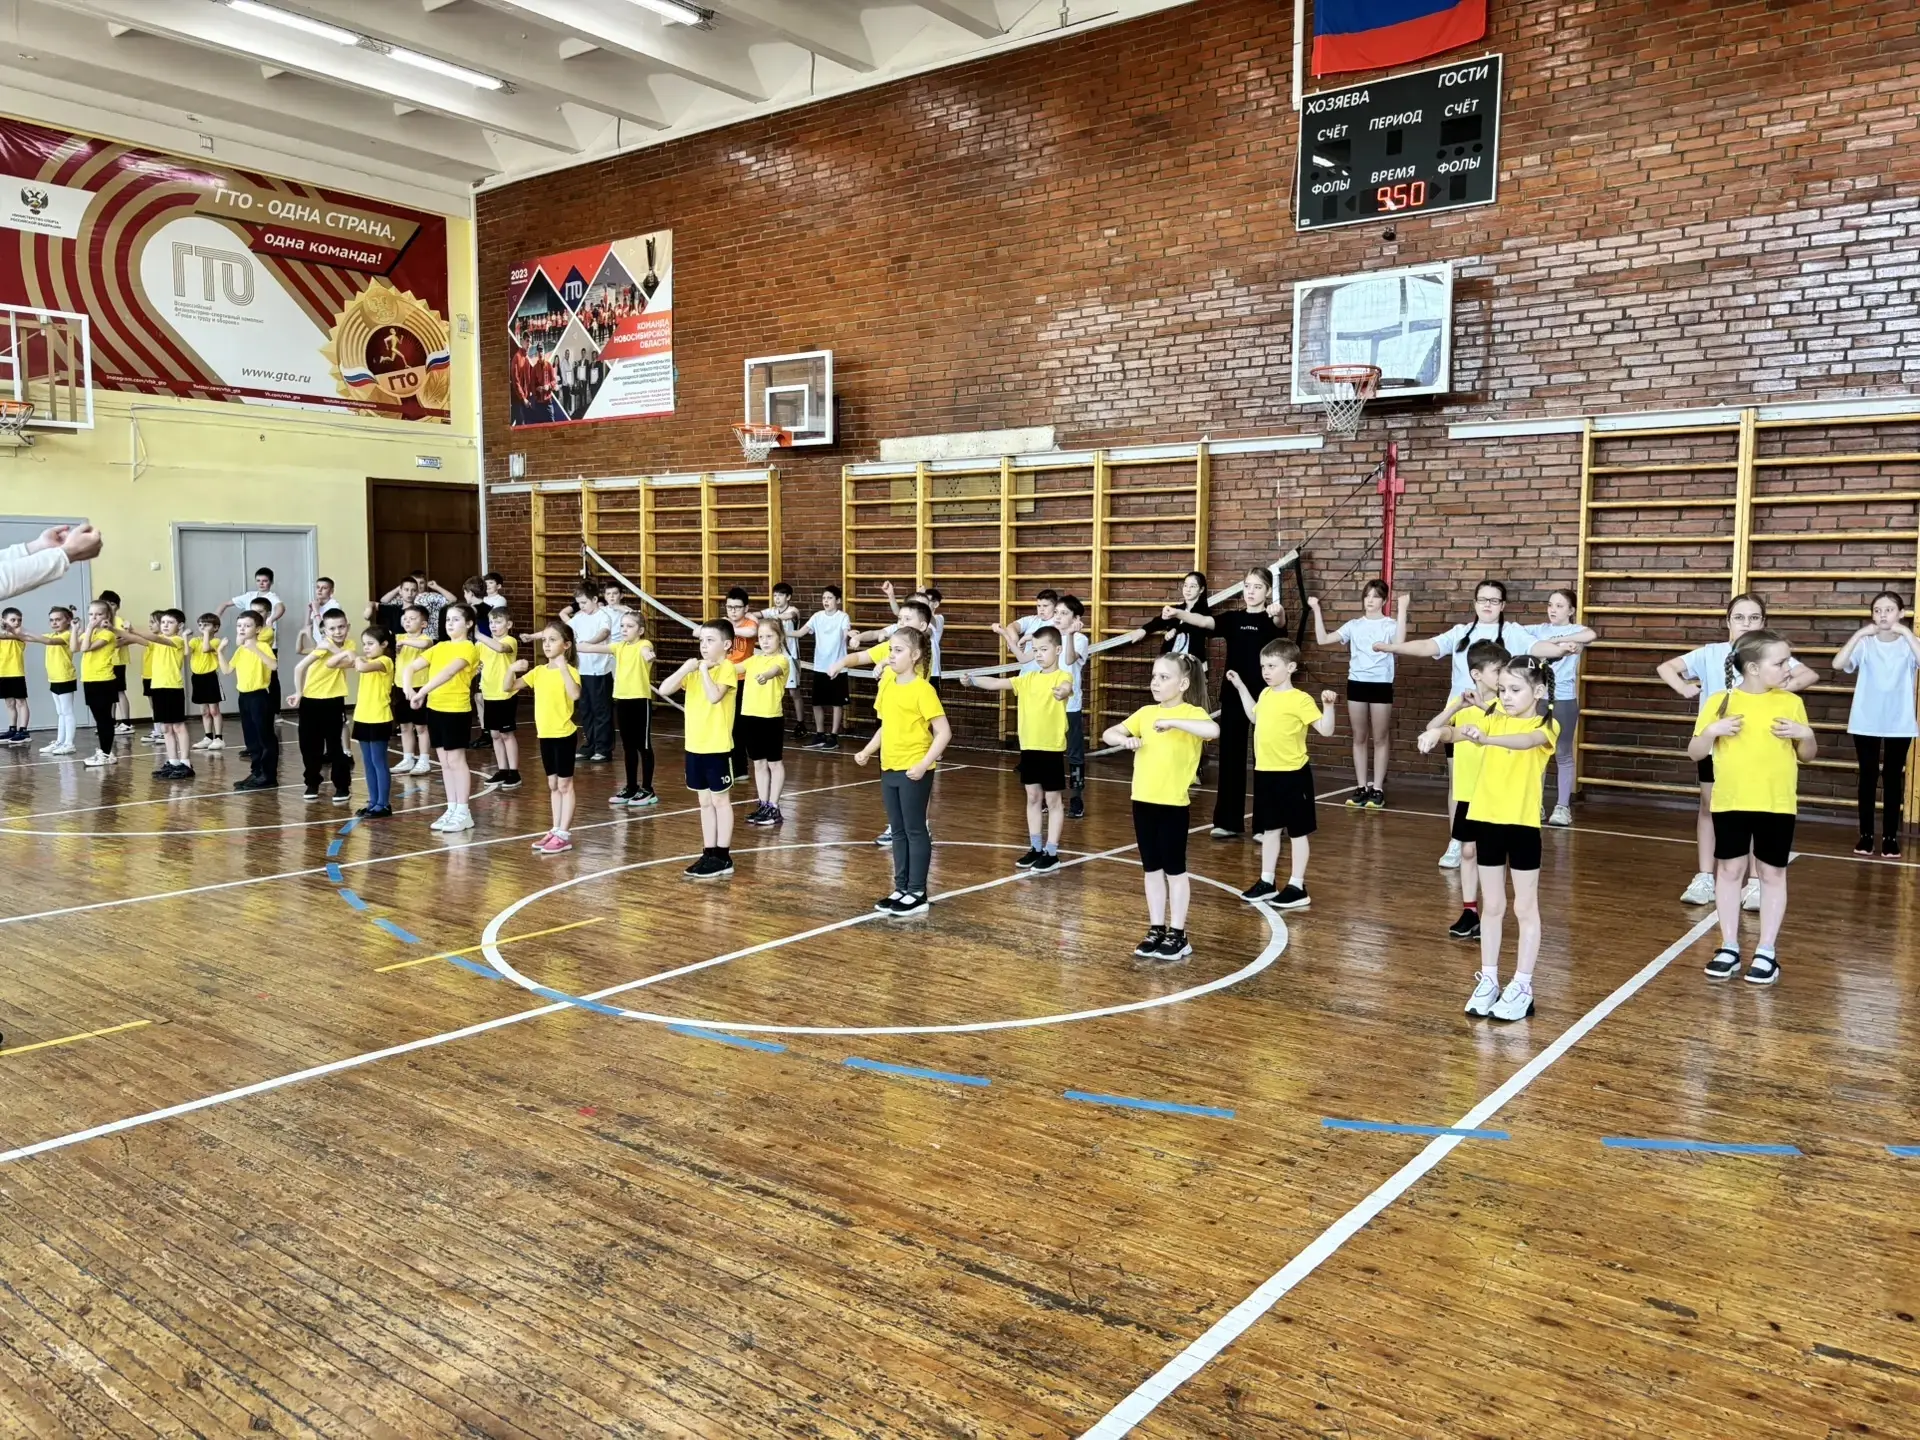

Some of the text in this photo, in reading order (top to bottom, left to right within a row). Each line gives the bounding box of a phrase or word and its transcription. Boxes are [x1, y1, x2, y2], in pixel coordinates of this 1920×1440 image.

[1438, 65, 1489, 89] ГОСТИ
[1306, 90, 1370, 115] ХОЗЯЕВА
[1445, 98, 1479, 117] СЧЁТ
[1369, 110, 1422, 131] ПЕРИОД
[1317, 124, 1348, 142] СЧЁТ
[1371, 165, 1416, 184] ВРЕМЯ
[1437, 156, 1481, 175] ФОЛЫ
[1311, 178, 1350, 195] ФОЛЫ
[215, 188, 252, 209] ГТО
[268, 200, 321, 224] ОДНА
[325, 212, 396, 242] СТРАНА,
[264, 233, 382, 265] одна команда!
[172, 241, 254, 306] ГТО
[510, 268, 528, 280] 2023
[565, 280, 583, 301] ГТО
[636, 319, 670, 331] КОМАНДА
[639, 337, 671, 349] ОБЛАСТИ
[241, 367, 311, 383] www.gto.ru
[388, 372, 418, 390] ГТО
[720, 775, 731, 785] 10
